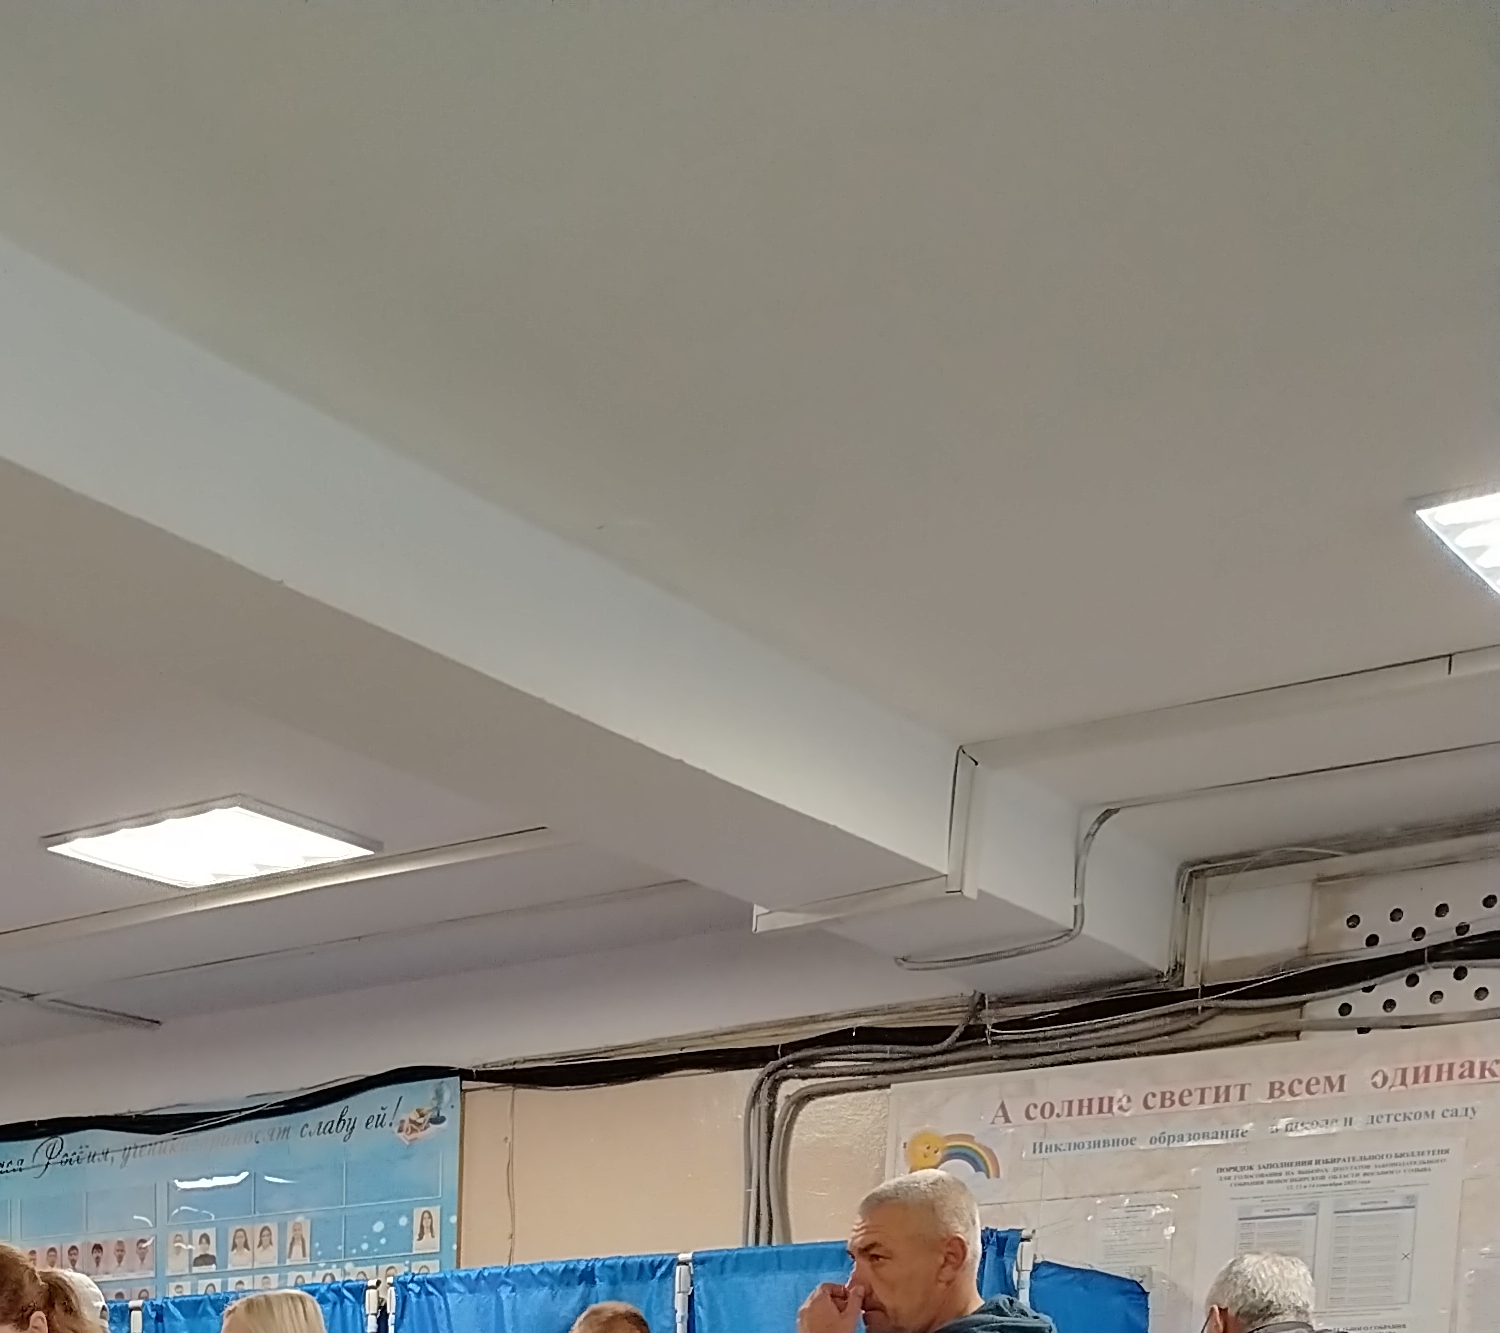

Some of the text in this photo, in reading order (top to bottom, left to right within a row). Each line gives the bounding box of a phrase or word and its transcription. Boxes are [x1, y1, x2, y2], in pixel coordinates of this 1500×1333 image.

[299, 1105, 357, 1142] славу
[364, 1096, 404, 1131] ей!
[990, 1100, 1013, 1125] А
[1024, 1093, 1132, 1121] солнце
[1142, 1081, 1252, 1110] светит
[1267, 1072, 1347, 1100] всем
[1032, 1135, 1137, 1155] Инклюзивное
[1149, 1126, 1249, 1147] образование
[1365, 1108, 1435, 1126] детском
[1441, 1105, 1478, 1120] саду
